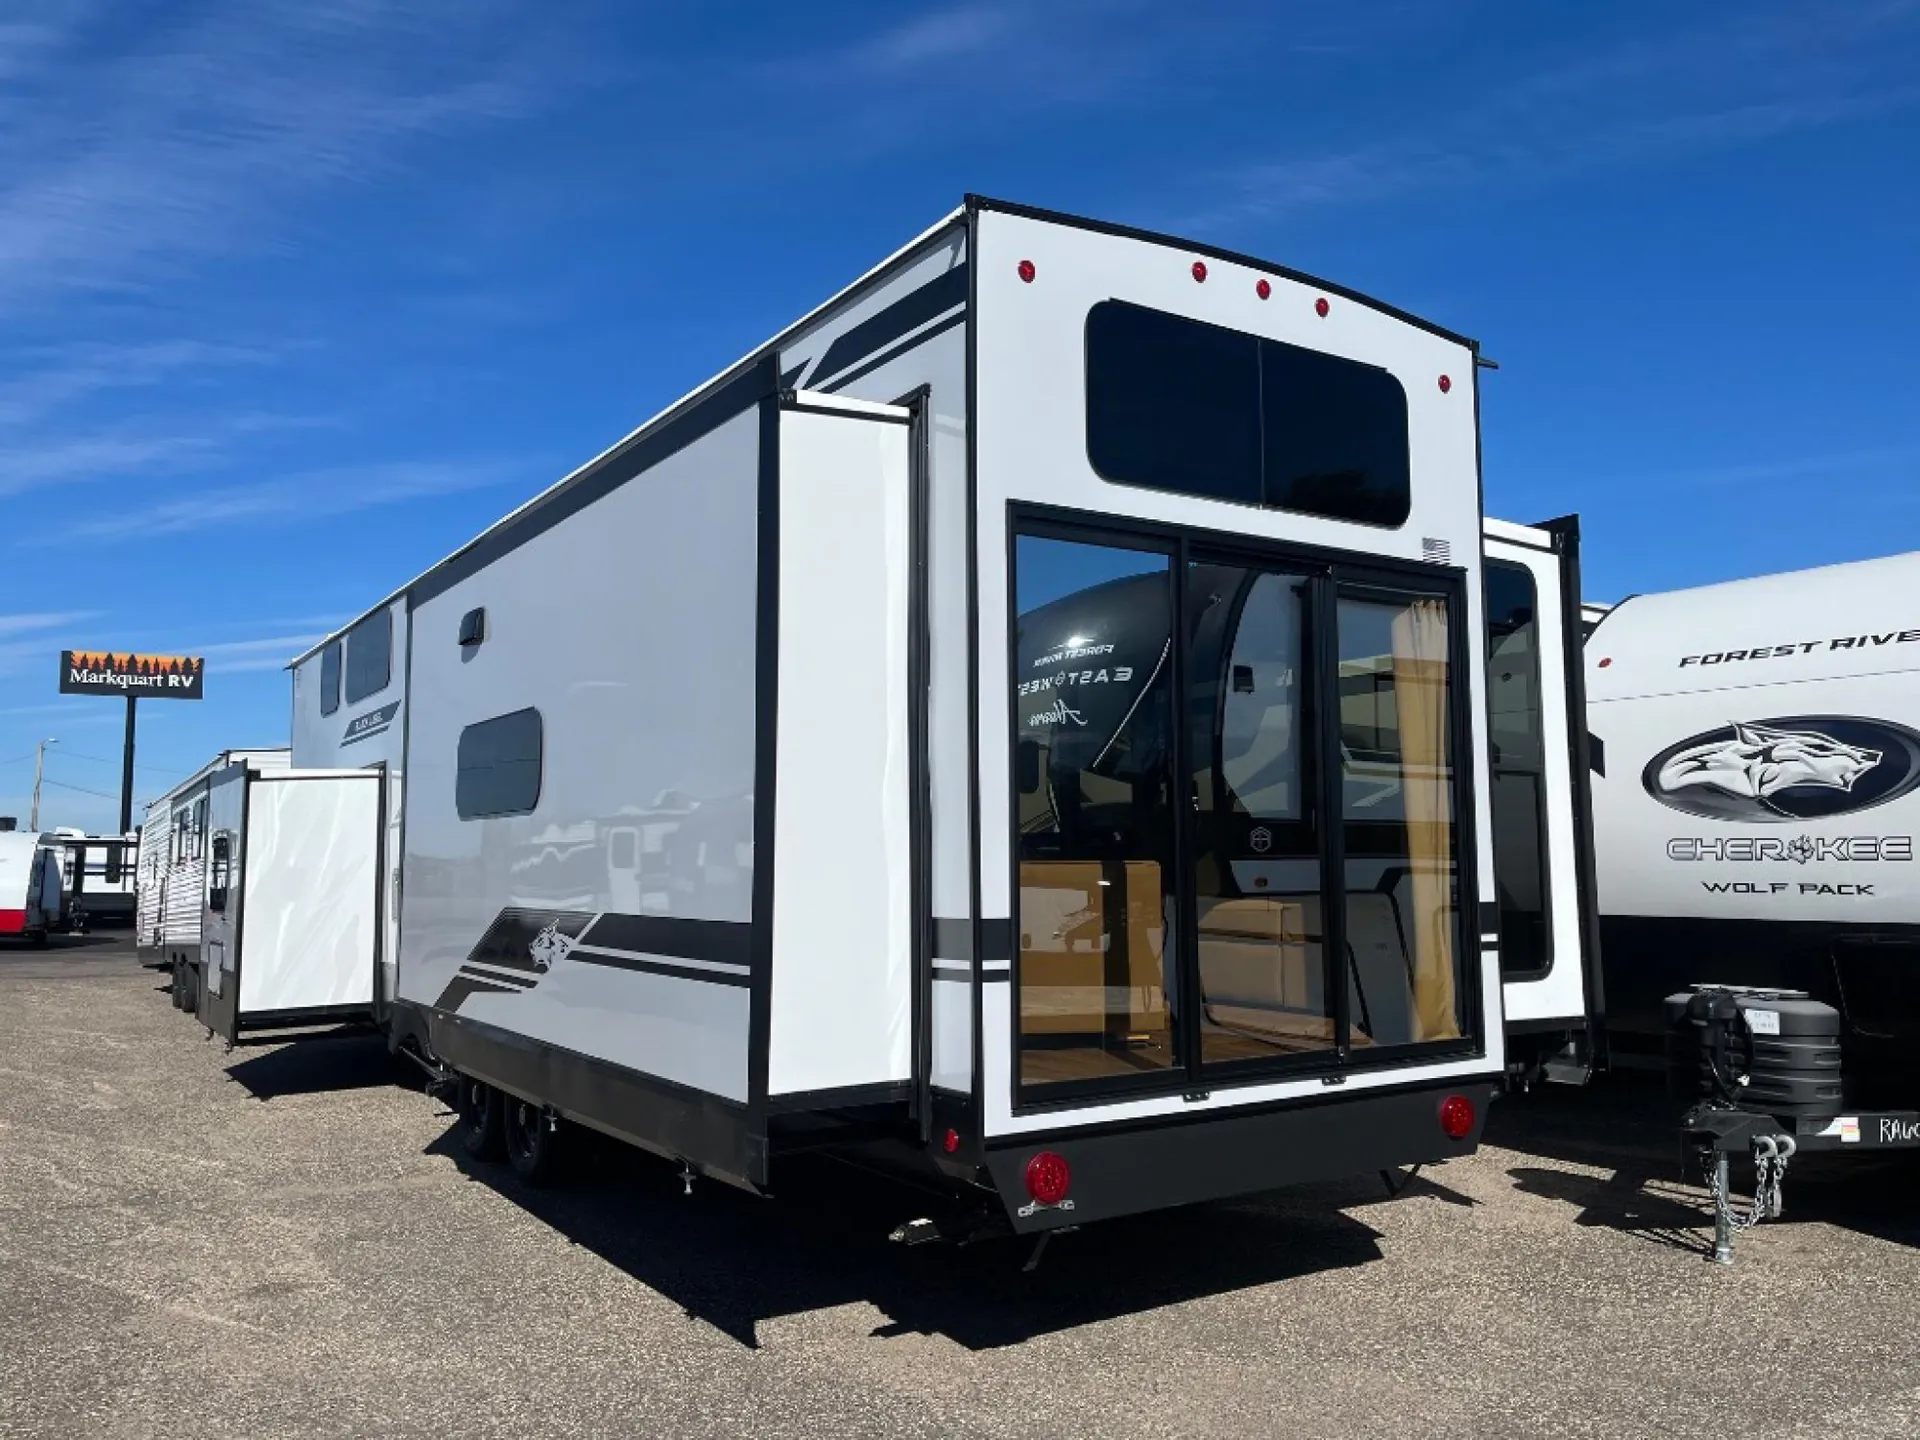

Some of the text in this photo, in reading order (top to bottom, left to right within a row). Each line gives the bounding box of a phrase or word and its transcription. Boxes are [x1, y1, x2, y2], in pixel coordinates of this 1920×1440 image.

[1678, 629, 1920, 668] FOREST RIVE
[69, 668, 194, 689] Markquart RV
[1666, 834, 1913, 864] CHEROKEE
[1701, 880, 1875, 896] WOLF PACK
